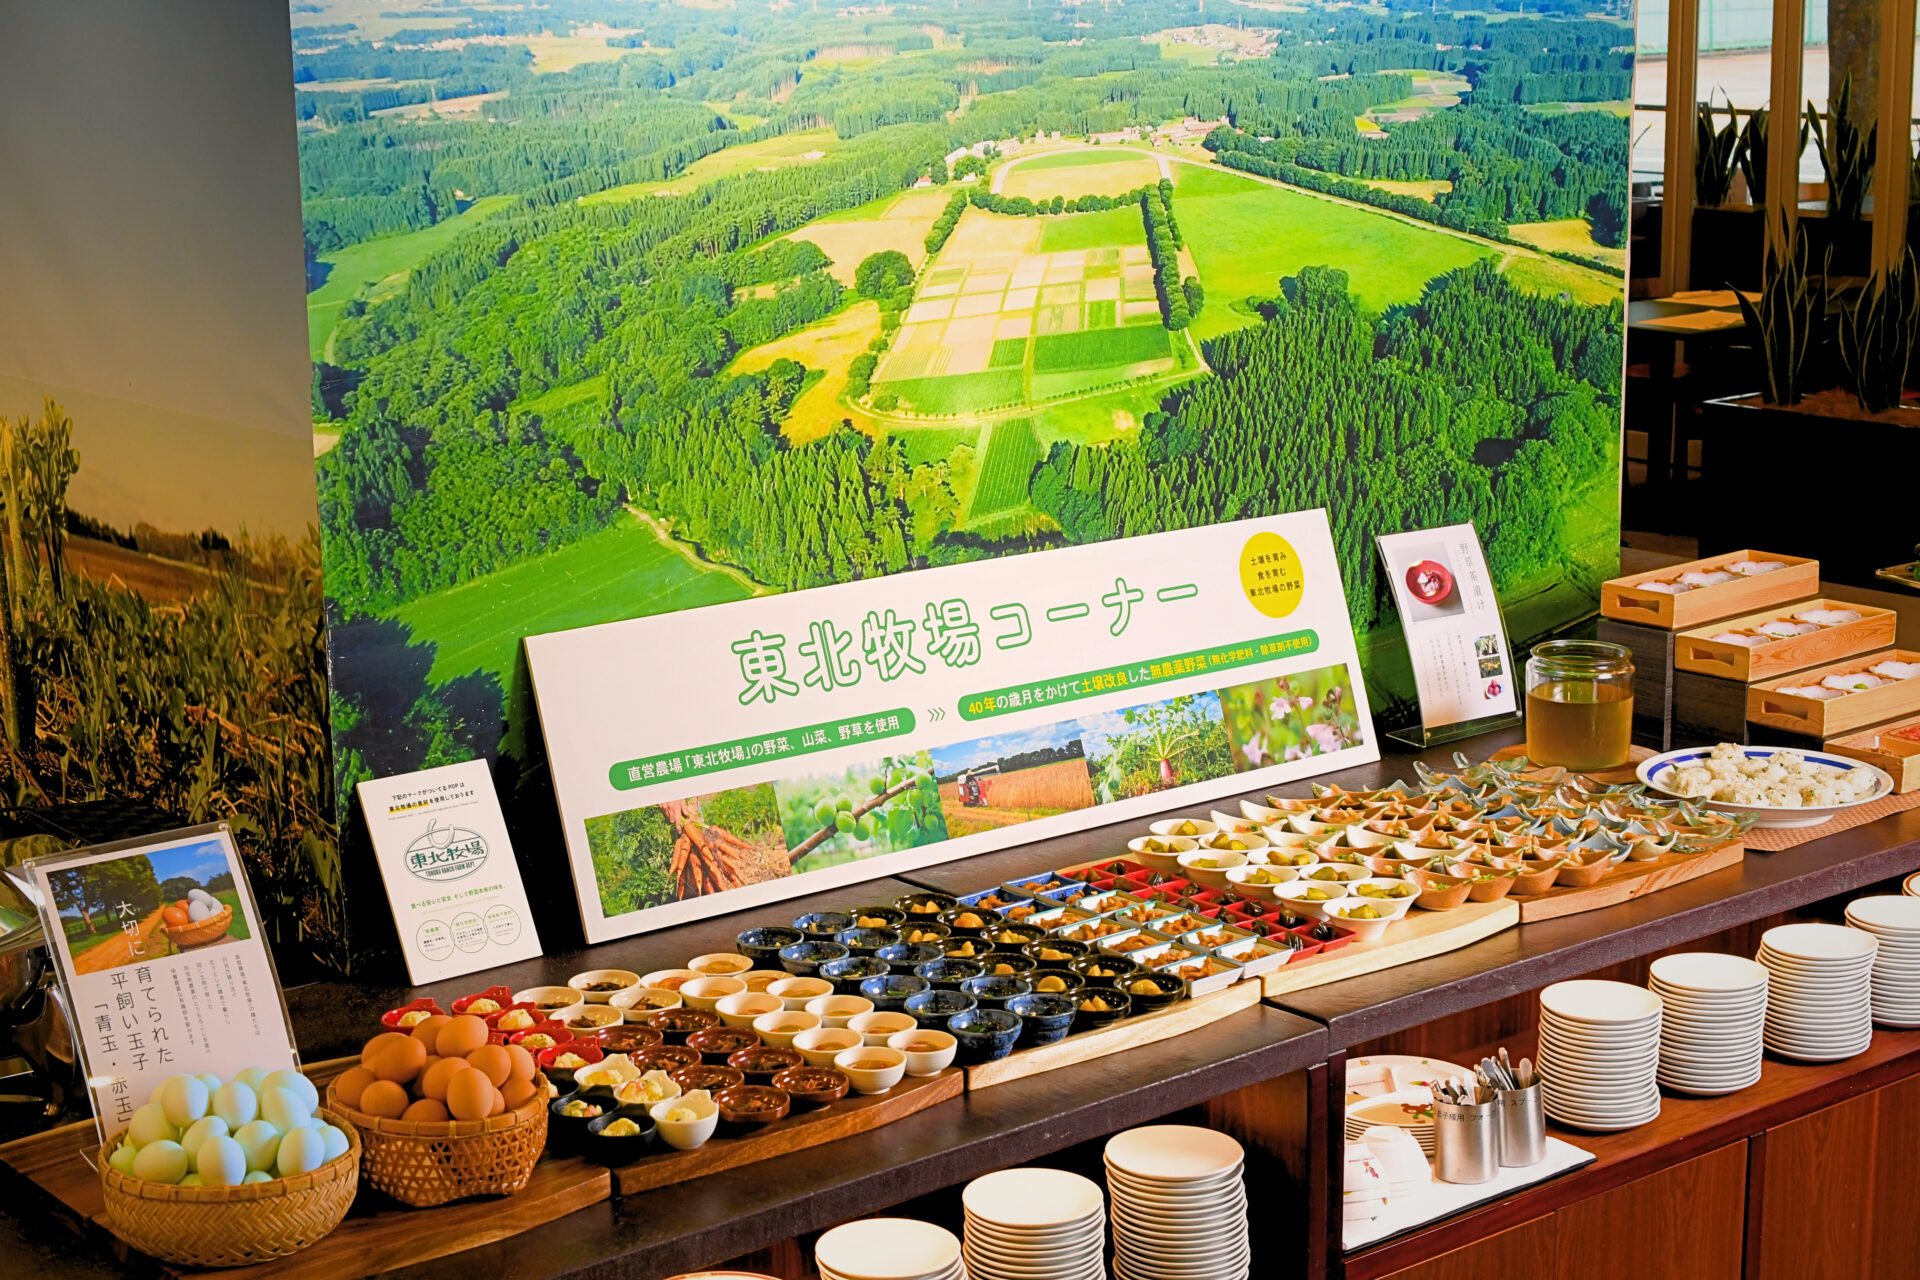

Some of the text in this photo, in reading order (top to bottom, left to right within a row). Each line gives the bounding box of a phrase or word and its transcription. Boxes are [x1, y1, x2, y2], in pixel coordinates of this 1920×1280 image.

[1250, 552, 1287, 566] 土壌を育み
[1257, 568, 1286, 580] 食を育む
[1249, 580, 1301, 597] 東北牧場の野菜
[731, 577, 1199, 706] 東北牧場コーナー
[410, 840, 485, 869] 東北牧場
[110, 971, 149, 1071] 平飼い玉子
